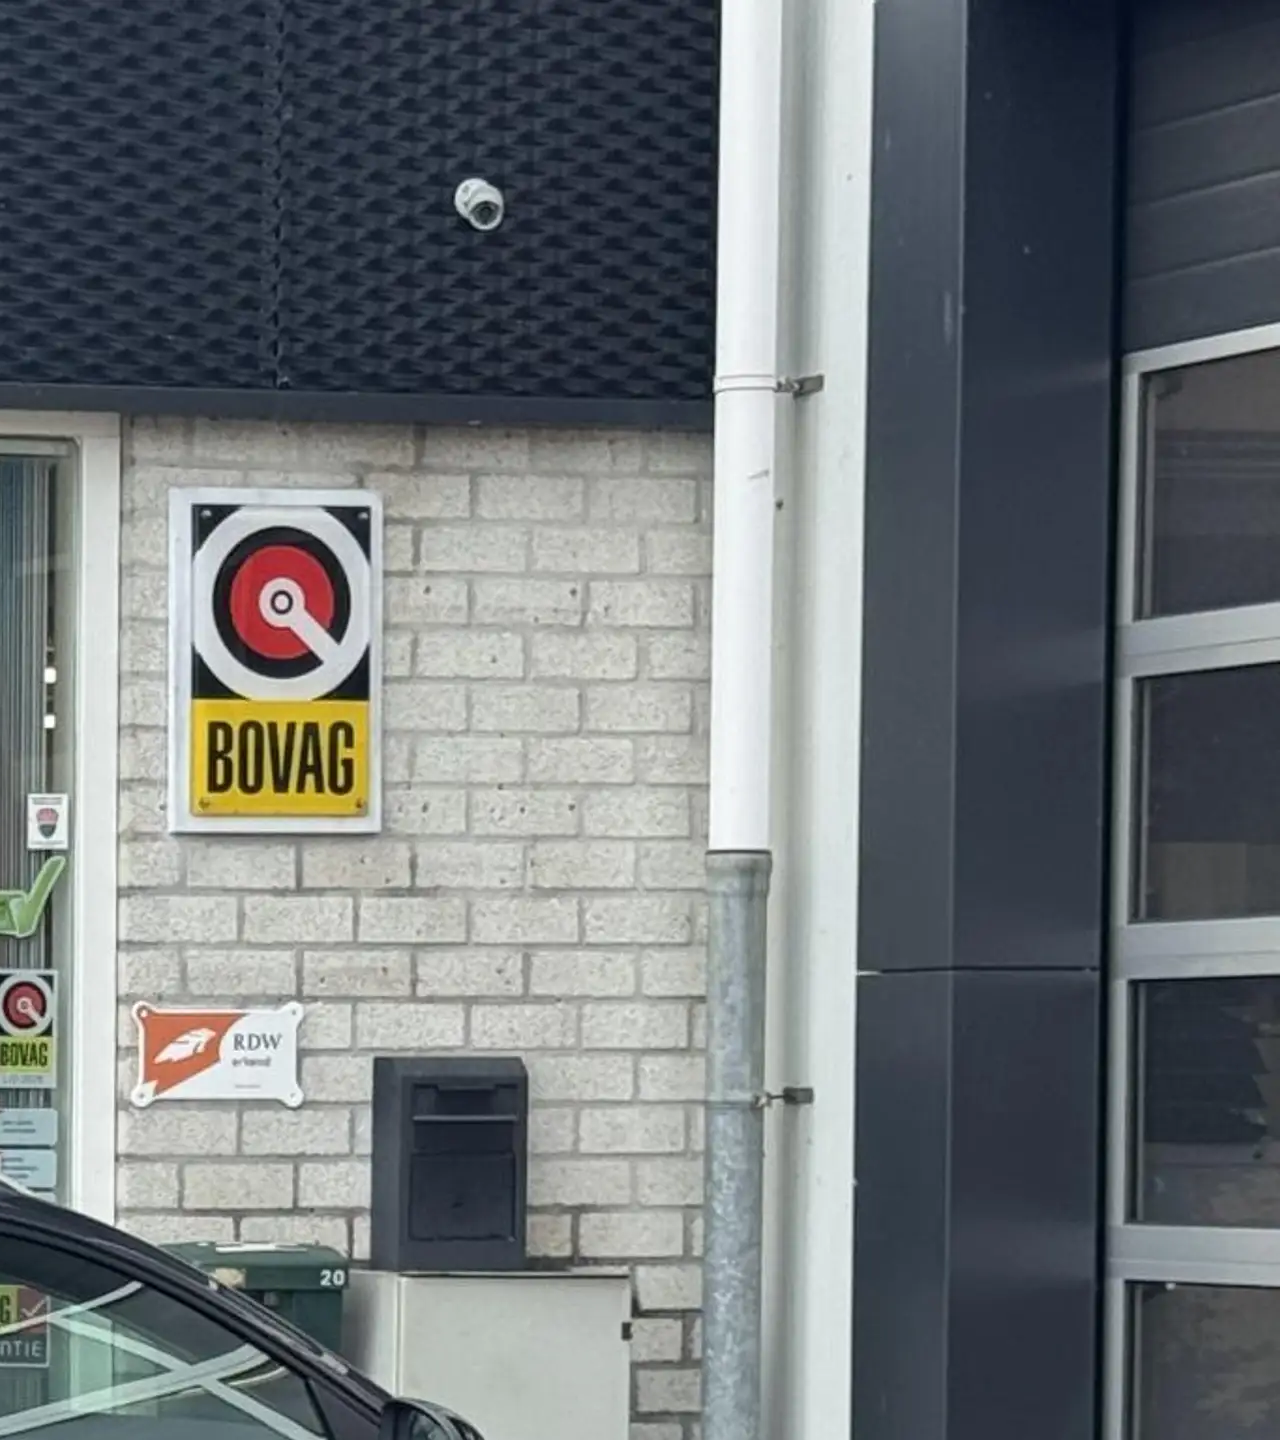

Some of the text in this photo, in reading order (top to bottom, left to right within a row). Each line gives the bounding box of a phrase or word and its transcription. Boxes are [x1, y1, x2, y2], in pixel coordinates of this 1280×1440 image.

[207, 720, 354, 795] BOVAG
[233, 1033, 282, 1051] RDW
[0, 1042, 49, 1067] BOVAG
[320, 1268, 346, 1287] 20
